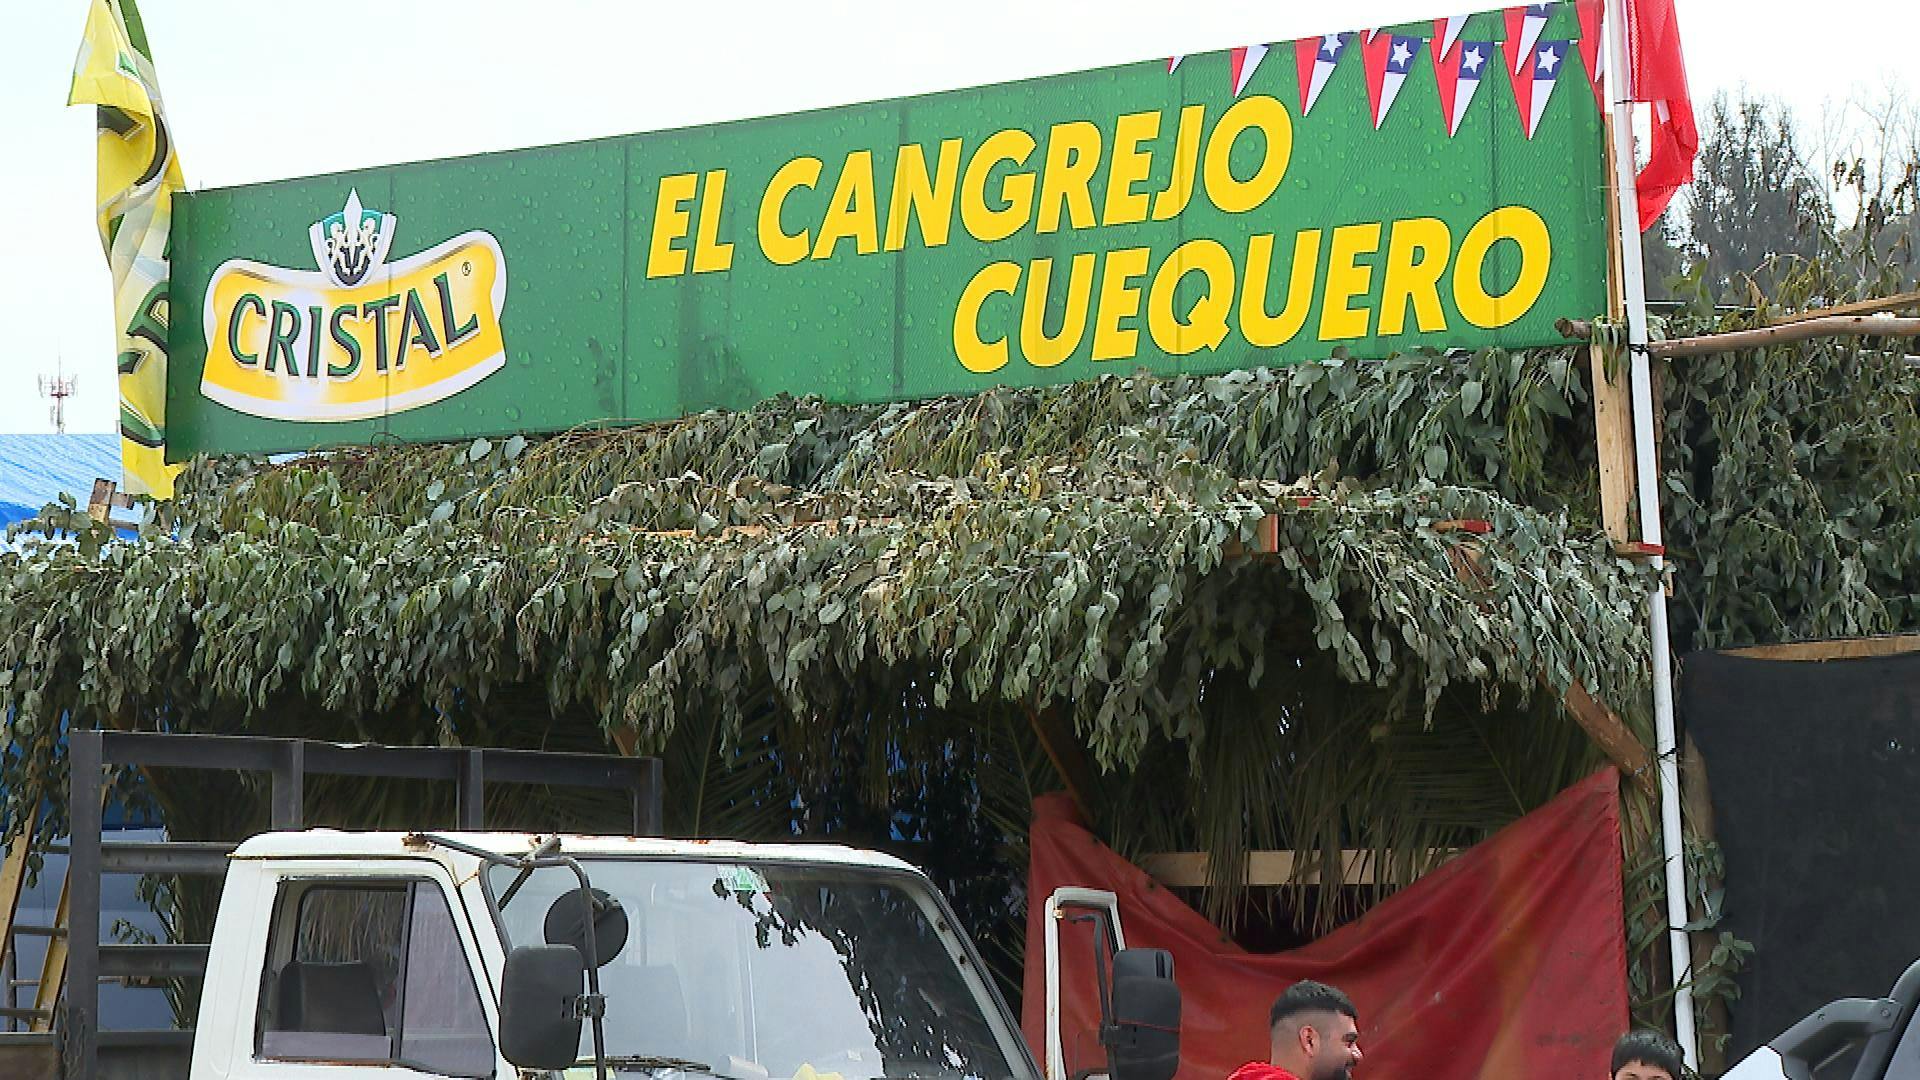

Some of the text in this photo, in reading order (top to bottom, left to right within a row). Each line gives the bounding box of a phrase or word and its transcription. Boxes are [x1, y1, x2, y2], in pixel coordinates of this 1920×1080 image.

[646, 95, 1293, 279] EL CANGREJO
[228, 271, 480, 380] CRISTAL
[952, 205, 1551, 373] CUEQUERO
